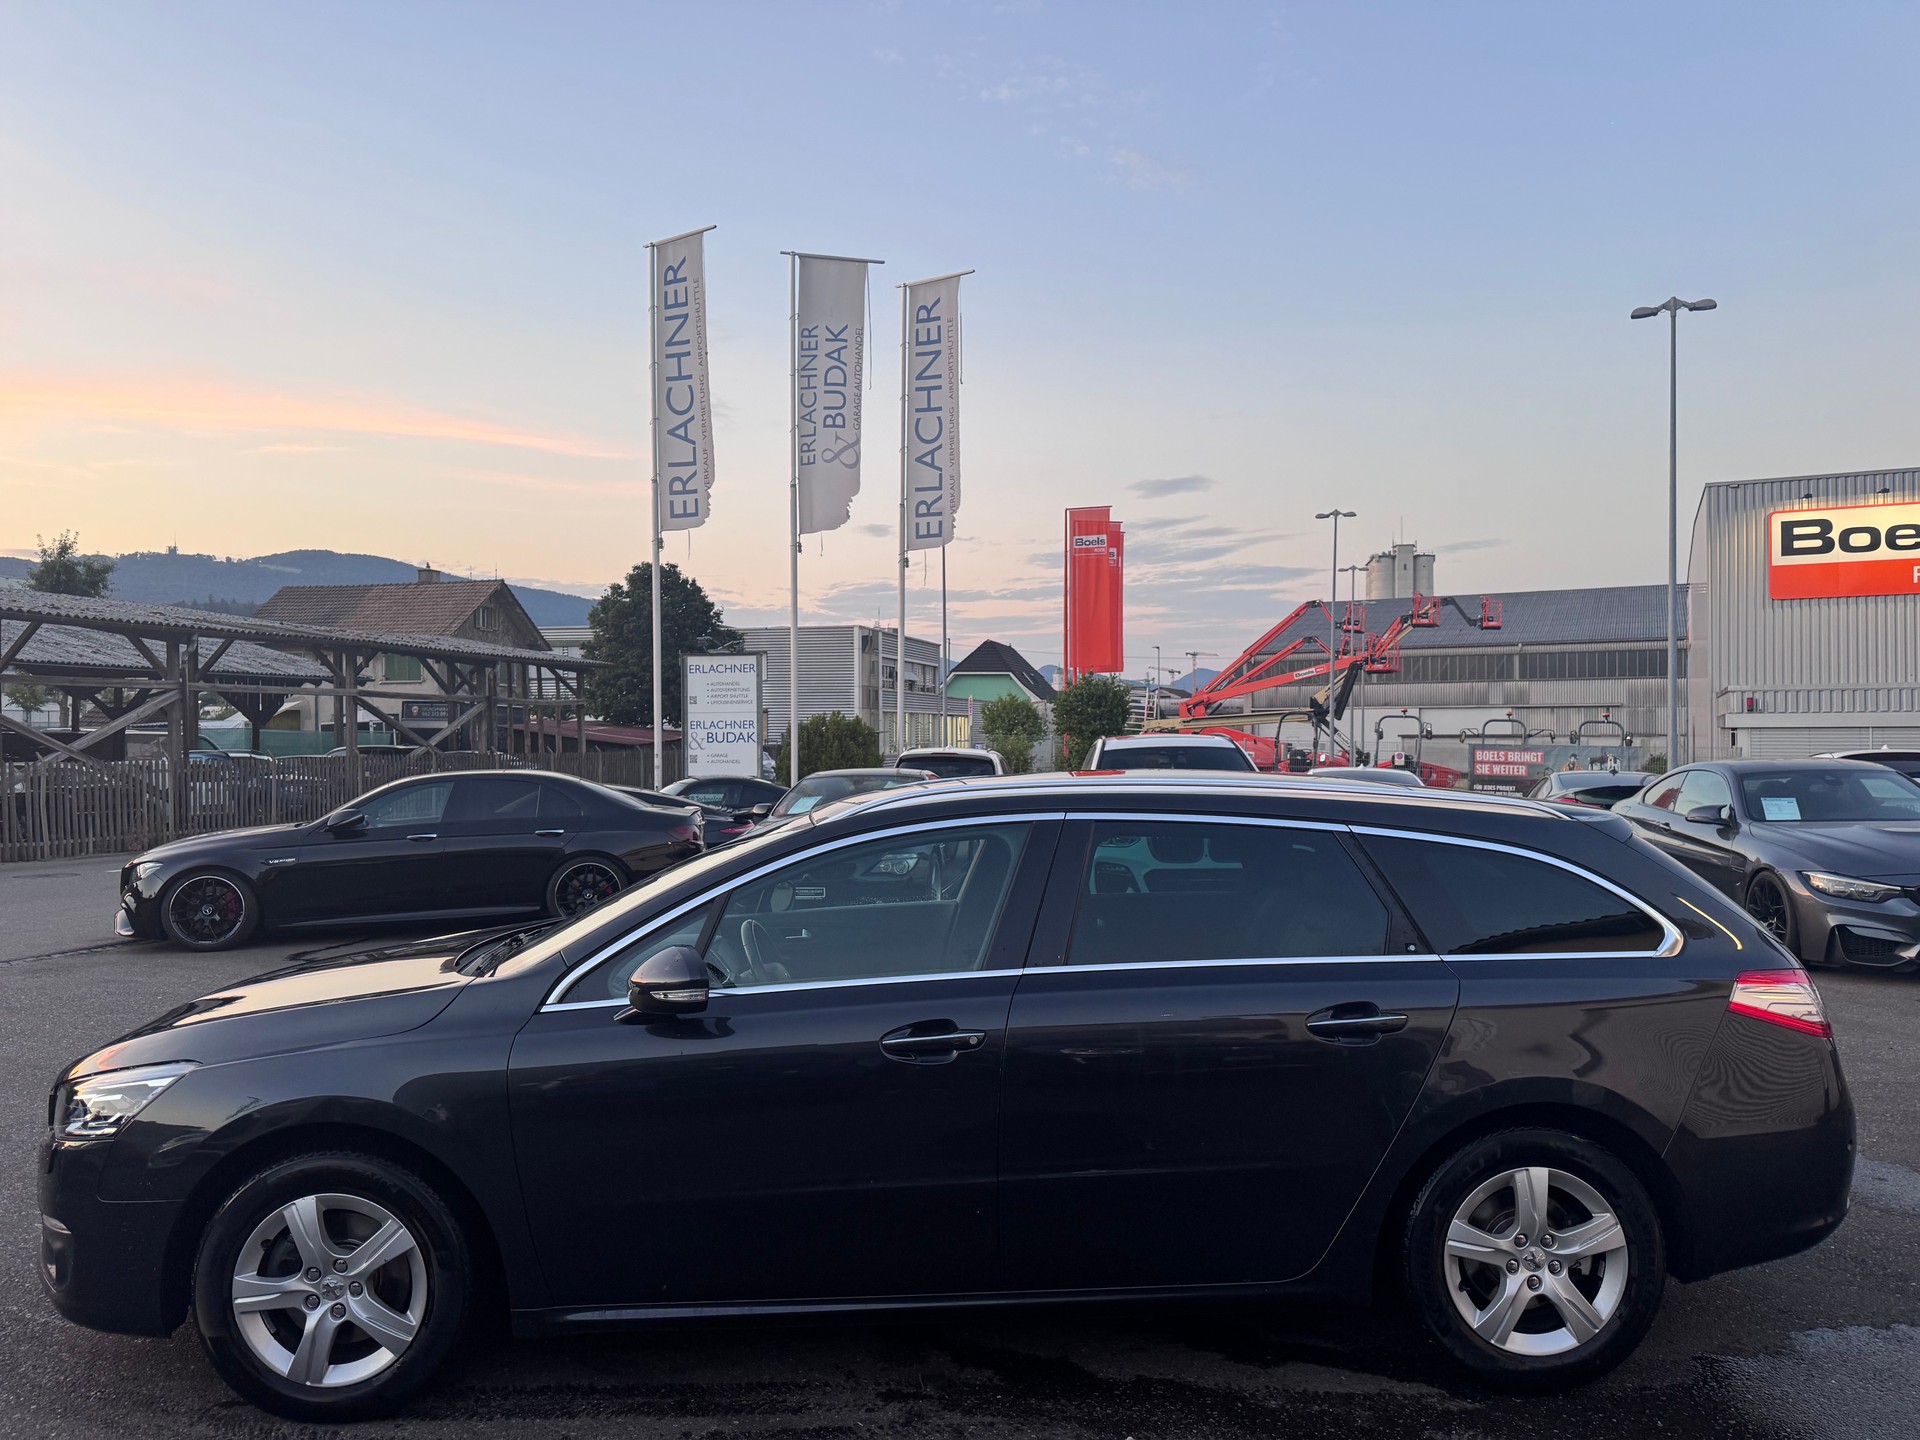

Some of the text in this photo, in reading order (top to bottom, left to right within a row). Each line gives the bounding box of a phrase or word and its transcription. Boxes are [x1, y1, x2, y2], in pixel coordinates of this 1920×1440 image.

[947, 317, 955, 400] AIRPORTSHUTTLE
[663, 256, 699, 519] ERLACHNER
[692, 277, 711, 492] VERKAUF VERMIETUNG AIRPORTSHUTTLE
[800, 324, 819, 467] ERLACHNER
[821, 323, 860, 470] & BUDAK
[853, 327, 863, 431] GARAGE AUTOHANDEL
[914, 297, 943, 540] ERLACHNER
[948, 473, 956, 515] VERKAUF
[1075, 537, 1106, 546] Boels
[1780, 518, 1920, 557] Boe
[688, 663, 756, 674] ERLACHNER
[1294, 669, 1315, 678] Boels
[689, 731, 757, 750] & BUDAK
[690, 720, 755, 730] ERLACHNER
[1475, 763, 1526, 775] SIE WEITER
[1476, 750, 1543, 763] BOELS BRINGT
